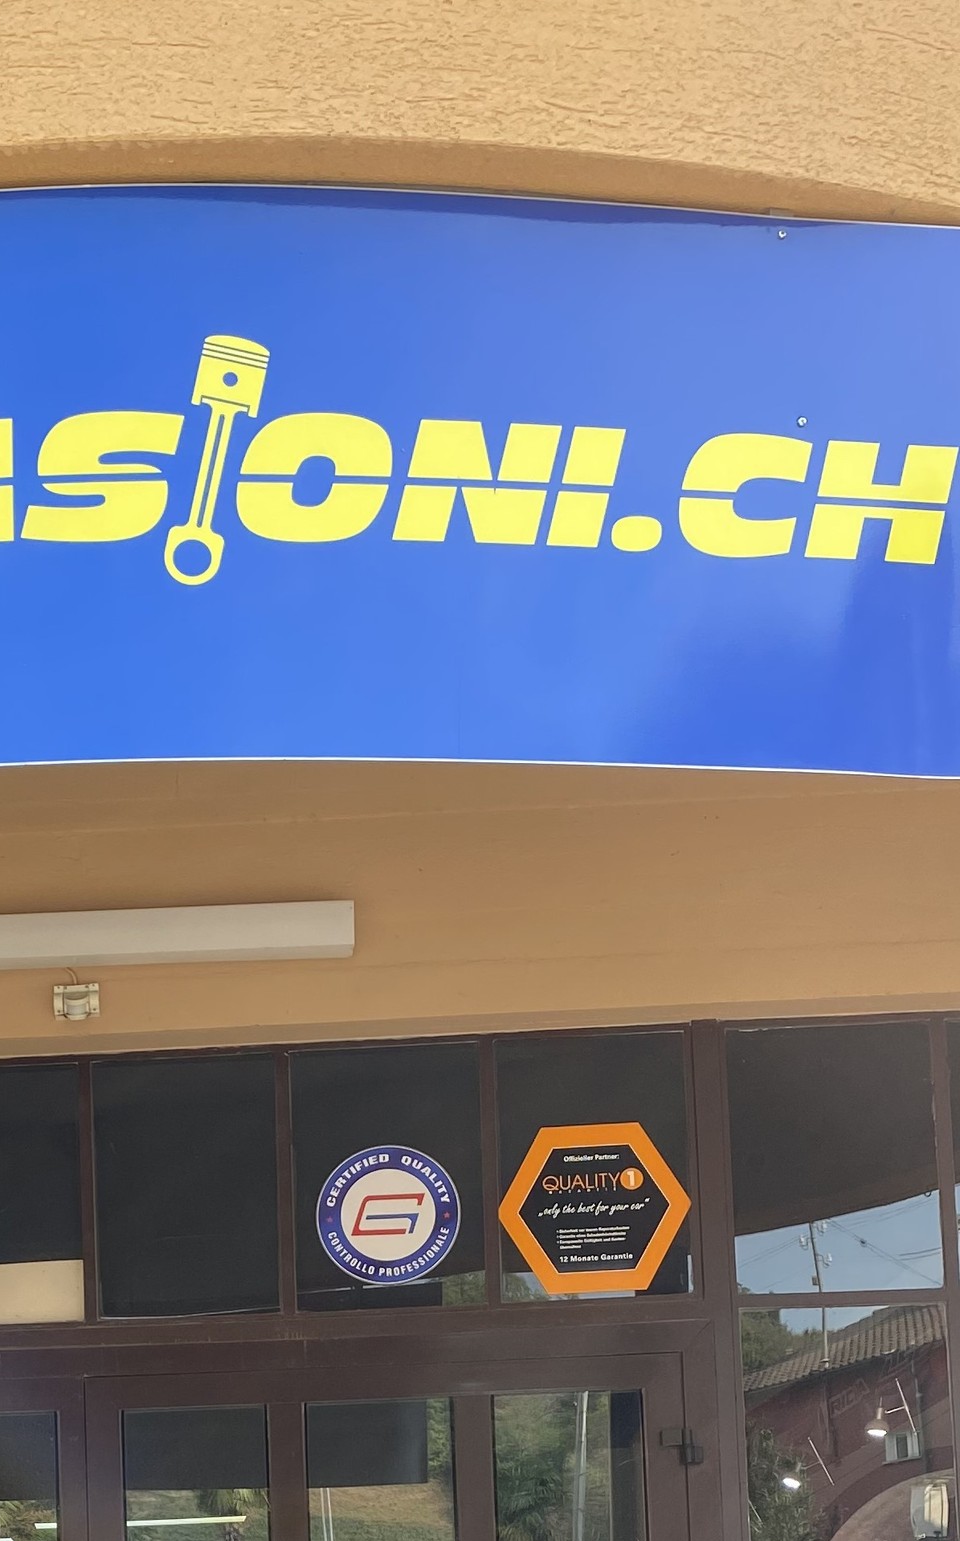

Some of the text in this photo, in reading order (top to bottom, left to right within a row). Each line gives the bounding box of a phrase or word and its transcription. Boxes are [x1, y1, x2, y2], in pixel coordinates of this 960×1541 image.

[326, 1153, 451, 1207] CERTIFIED QUALITY
[542, 1171, 620, 1191] QUALITY
[562, 1203, 576, 1214] the
[577, 1202, 596, 1214] best
[595, 1200, 610, 1216] for
[609, 1204, 629, 1215] your
[327, 1226, 450, 1277] CONTROLLO PROFESSIONALE
[600, 1252, 634, 1261] Garantie
